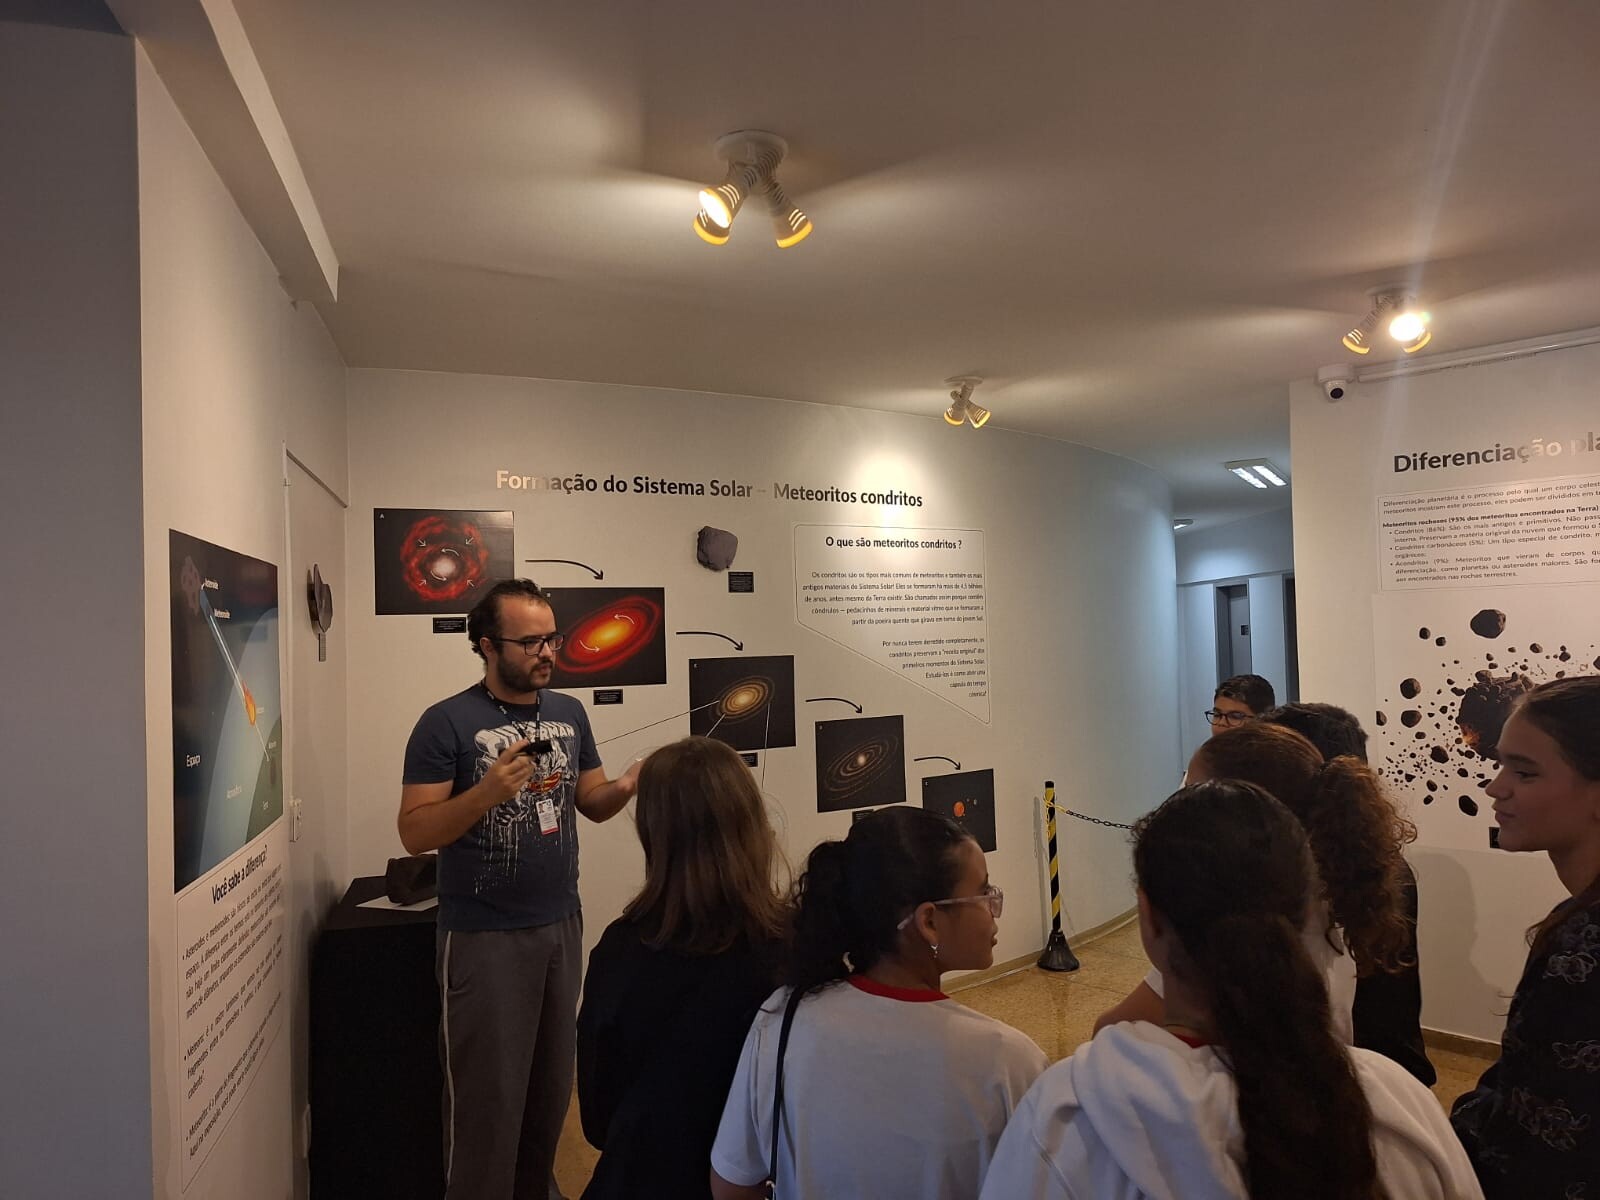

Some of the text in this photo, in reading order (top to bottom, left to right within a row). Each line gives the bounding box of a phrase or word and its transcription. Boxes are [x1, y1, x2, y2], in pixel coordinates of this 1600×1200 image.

[1394, 438, 1562, 473] Diferenciação
[496, 470, 923, 507] Formação do Sistema Solar Meteoritos condritos
[1383, 498, 1425, 507] Diferenciação
[1427, 495, 1459, 503] planetária
[1474, 491, 1504, 499] processo
[1506, 488, 1522, 496] pelo
[1383, 507, 1416, 515] meteoritos
[1509, 496, 1534, 504] podem
[1547, 491, 1580, 500] divididos
[1382, 520, 1417, 528] Meteoritos
[1480, 512, 1518, 520] meteoritos
[1519, 508, 1565, 517] encontrados
[1485, 528, 1510, 537] original
[1518, 535, 1546, 543] especial
[825, 536, 962, 549] O que são meteoritos condritos ?
[1461, 564, 1489, 572] planetas
[211, 876, 228, 905] Você
[227, 869, 241, 893] sabe
[241, 867, 245, 881] a
